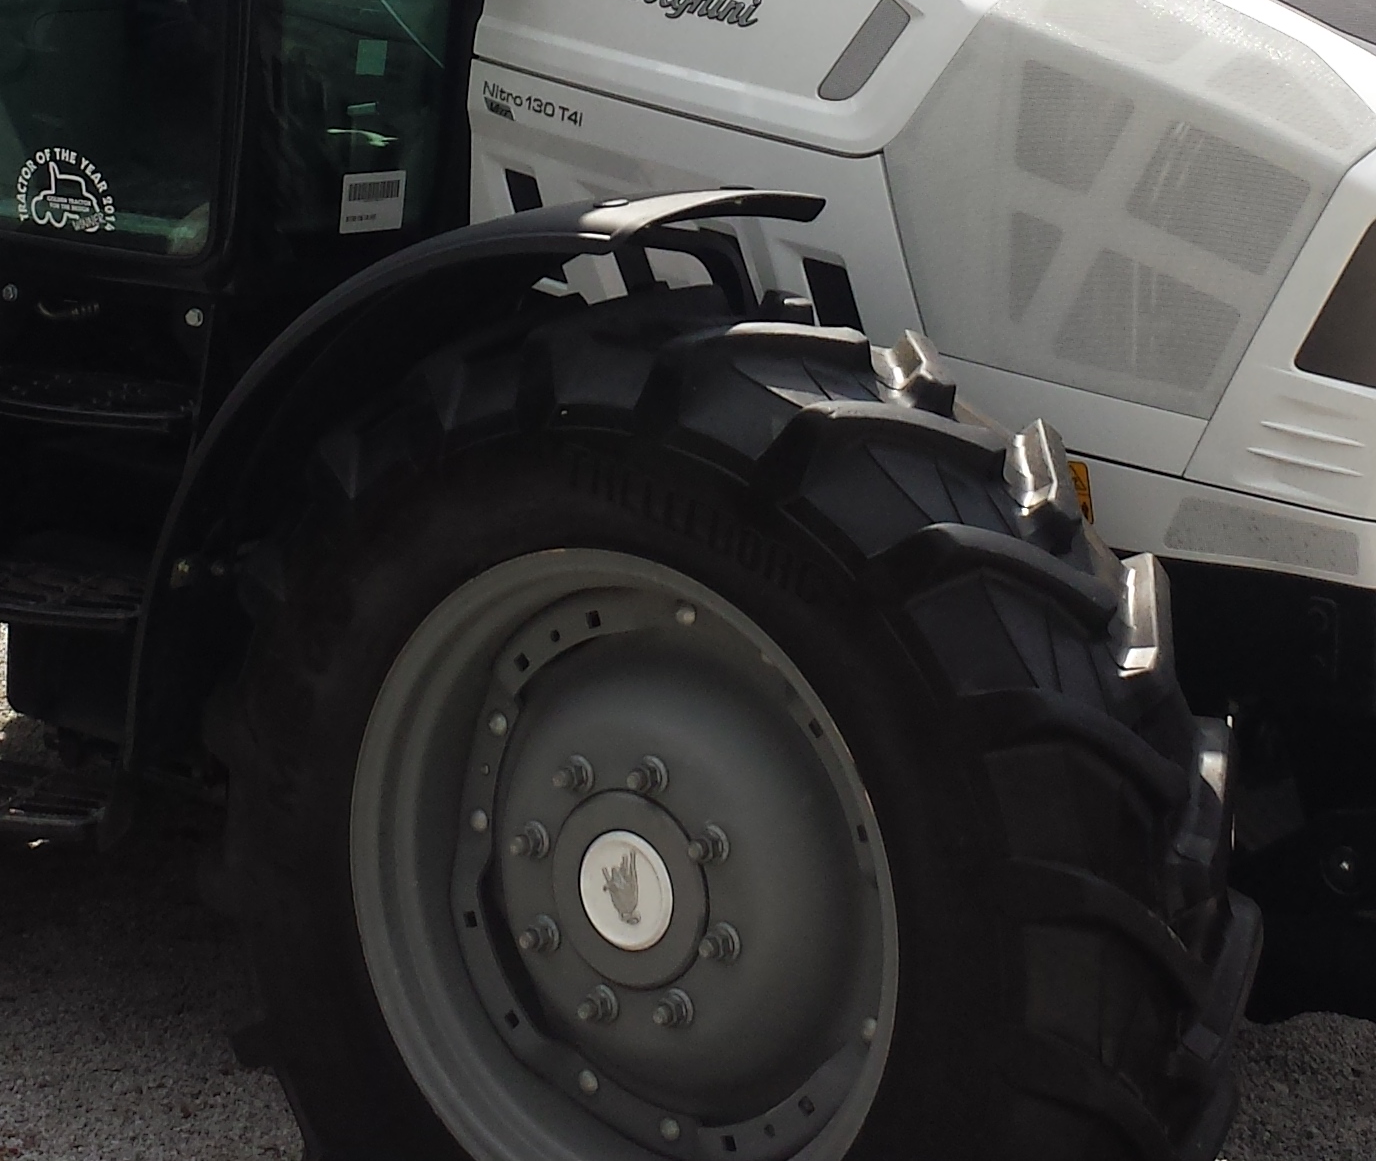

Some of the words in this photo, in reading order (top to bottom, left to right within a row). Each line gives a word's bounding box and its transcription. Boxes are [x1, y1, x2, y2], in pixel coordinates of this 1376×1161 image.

[483, 80, 523, 107] Nitro
[525, 95, 555, 118] 130
[16, 160, 38, 222] TRACTOR
[35, 148, 51, 164] OF
[53, 147, 77, 165] THE
[80, 157, 108, 193] YEAR
[102, 195, 116, 231] 2014
